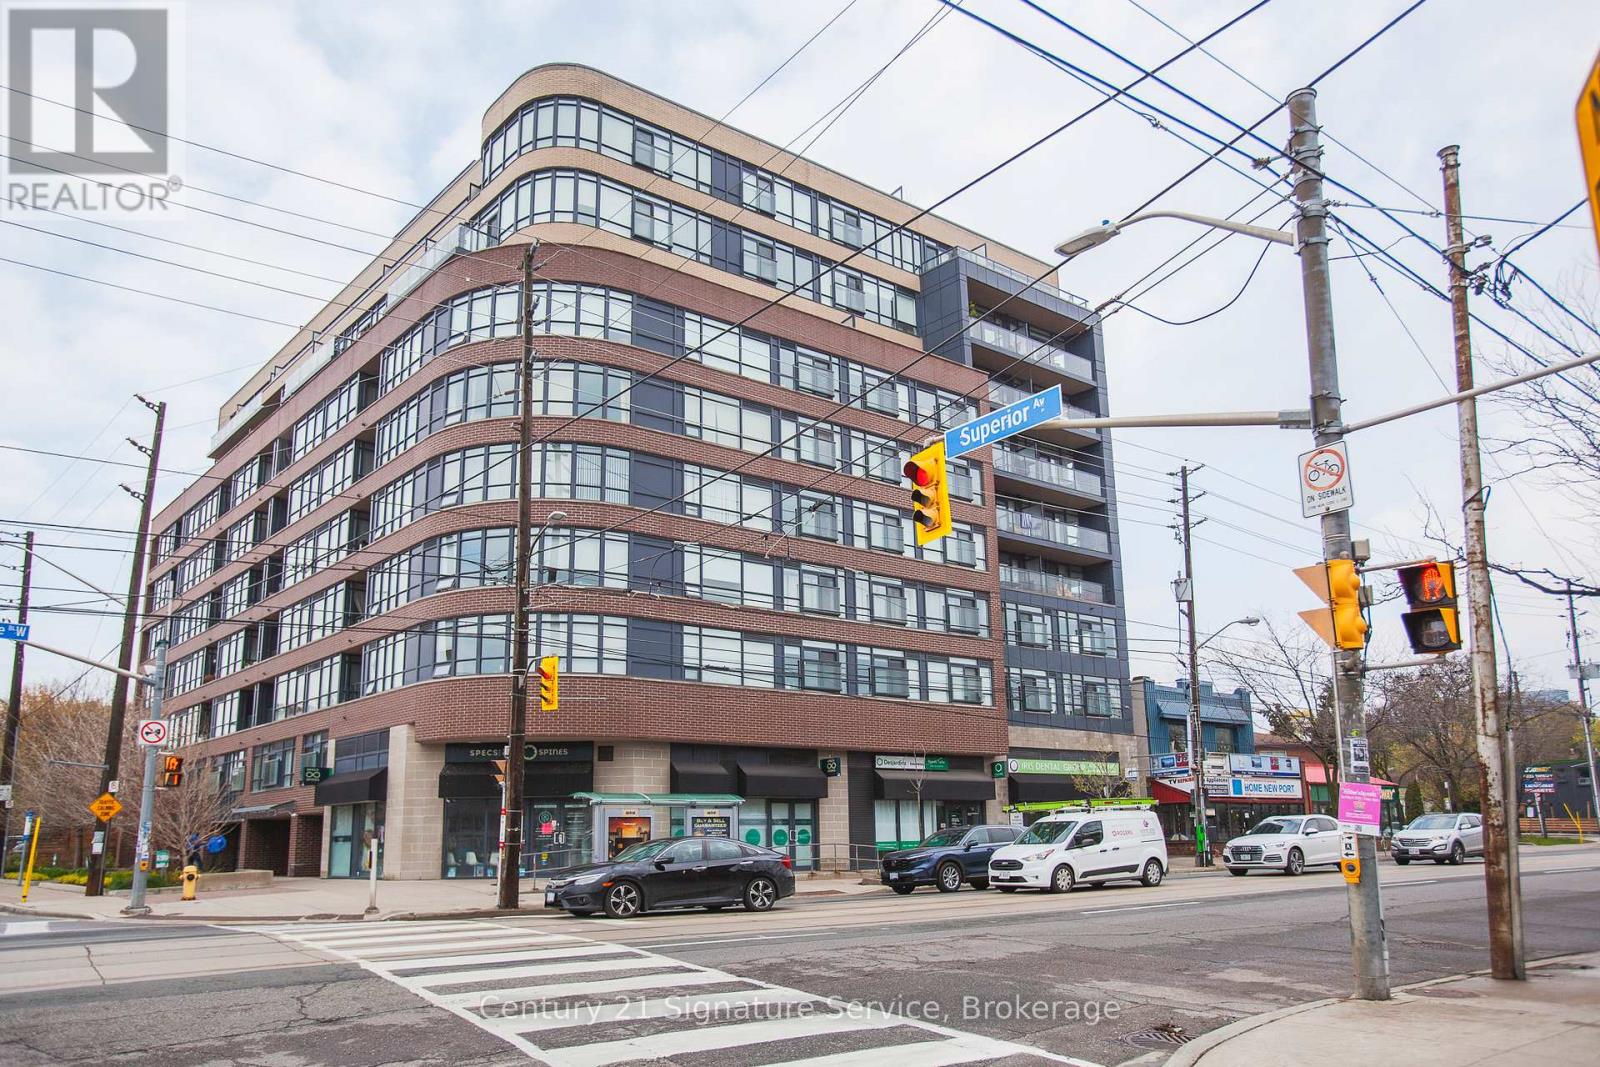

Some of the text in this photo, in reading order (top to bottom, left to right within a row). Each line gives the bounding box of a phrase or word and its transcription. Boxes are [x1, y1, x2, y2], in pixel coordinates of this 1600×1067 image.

[960, 405, 1030, 447] Superior
[1306, 486, 1346, 503] ON SIDEWALK
[16, 626, 27, 637] W
[469, 748, 569, 757] SPECS SPINES
[1245, 783, 1295, 793] HOME NEW PORT
